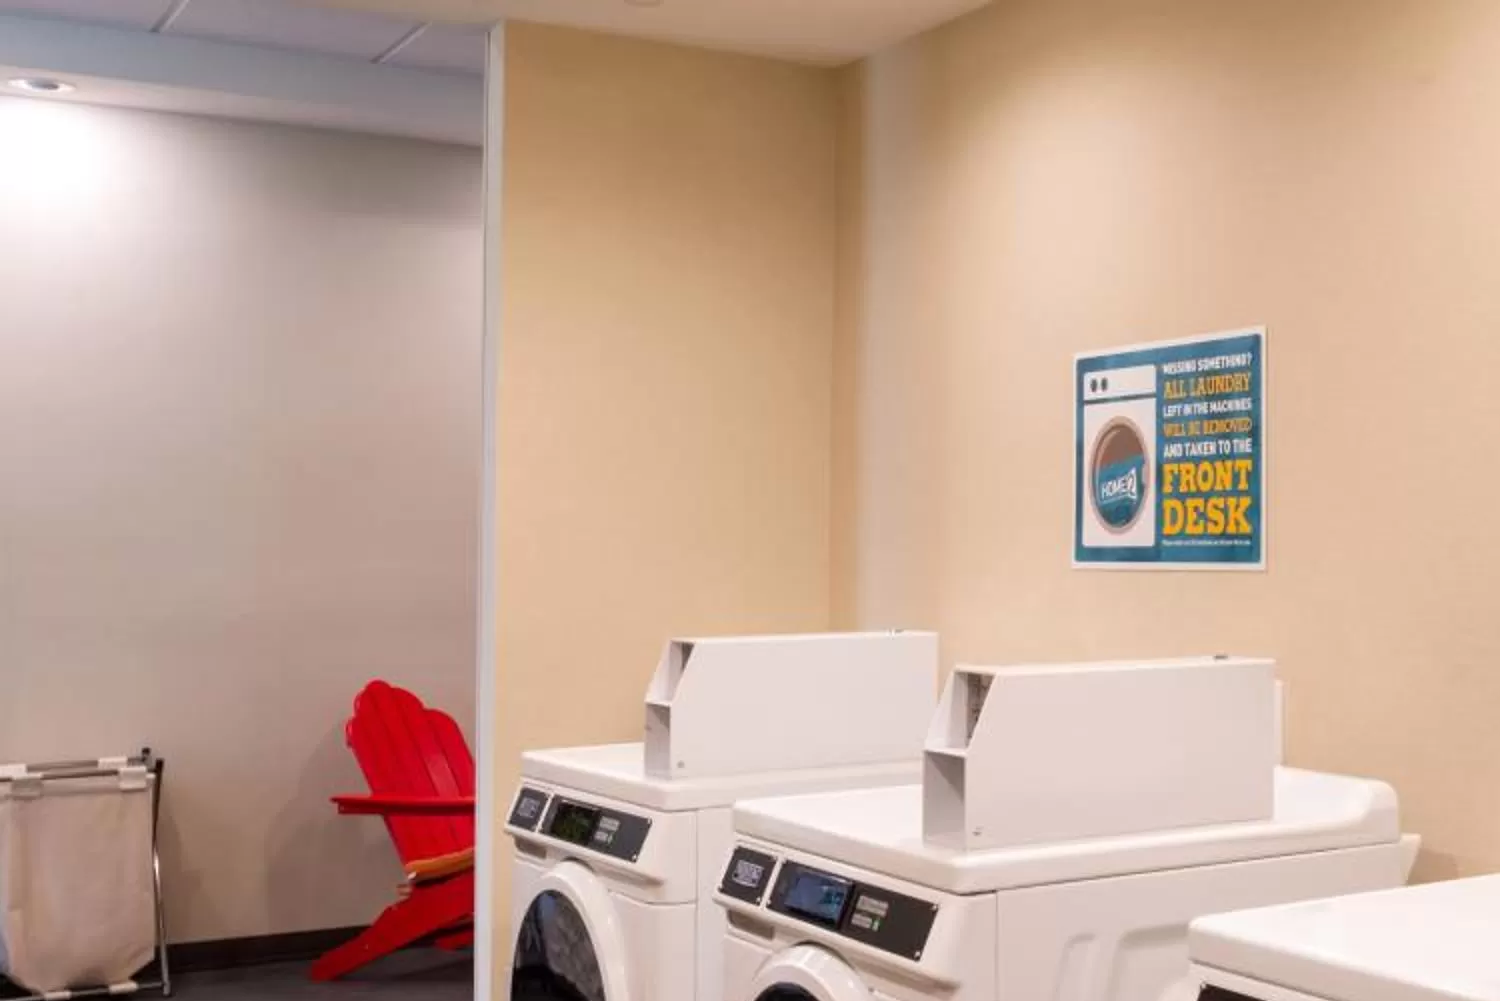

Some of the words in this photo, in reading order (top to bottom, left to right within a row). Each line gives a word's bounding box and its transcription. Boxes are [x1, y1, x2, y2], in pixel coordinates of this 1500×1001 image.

[1163, 379, 1187, 399] ALL
[1188, 372, 1252, 396] LAUNDRY
[1163, 404, 1182, 417] LEFT
[1163, 443, 1183, 458] AND
[1185, 440, 1217, 457] TAKEN
[1218, 439, 1231, 455] TO
[1232, 437, 1253, 453] THE
[1162, 459, 1253, 493] FRONT
[1162, 496, 1253, 535] DESK
